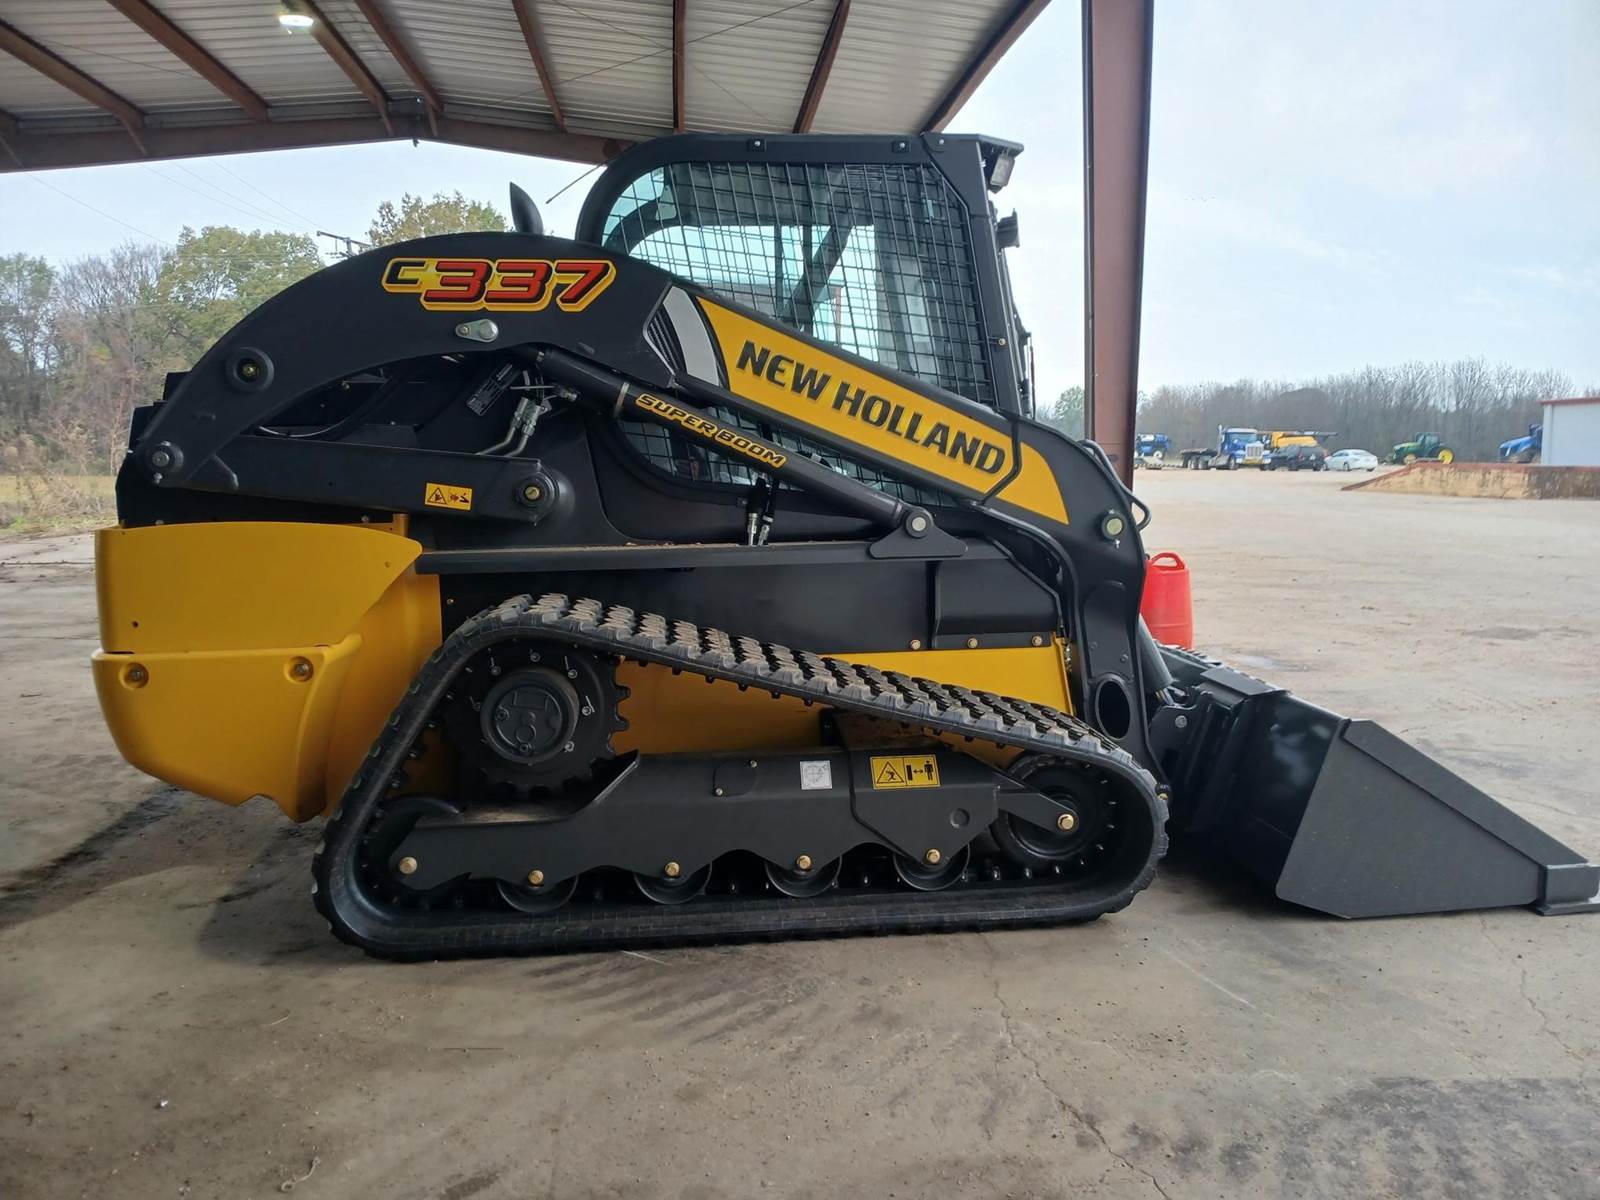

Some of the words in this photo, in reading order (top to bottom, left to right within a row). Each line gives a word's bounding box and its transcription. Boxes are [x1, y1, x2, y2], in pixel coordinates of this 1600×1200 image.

[382, 257, 617, 313] C337
[736, 339, 832, 401] NEW
[831, 380, 1006, 475] HOLLAND
